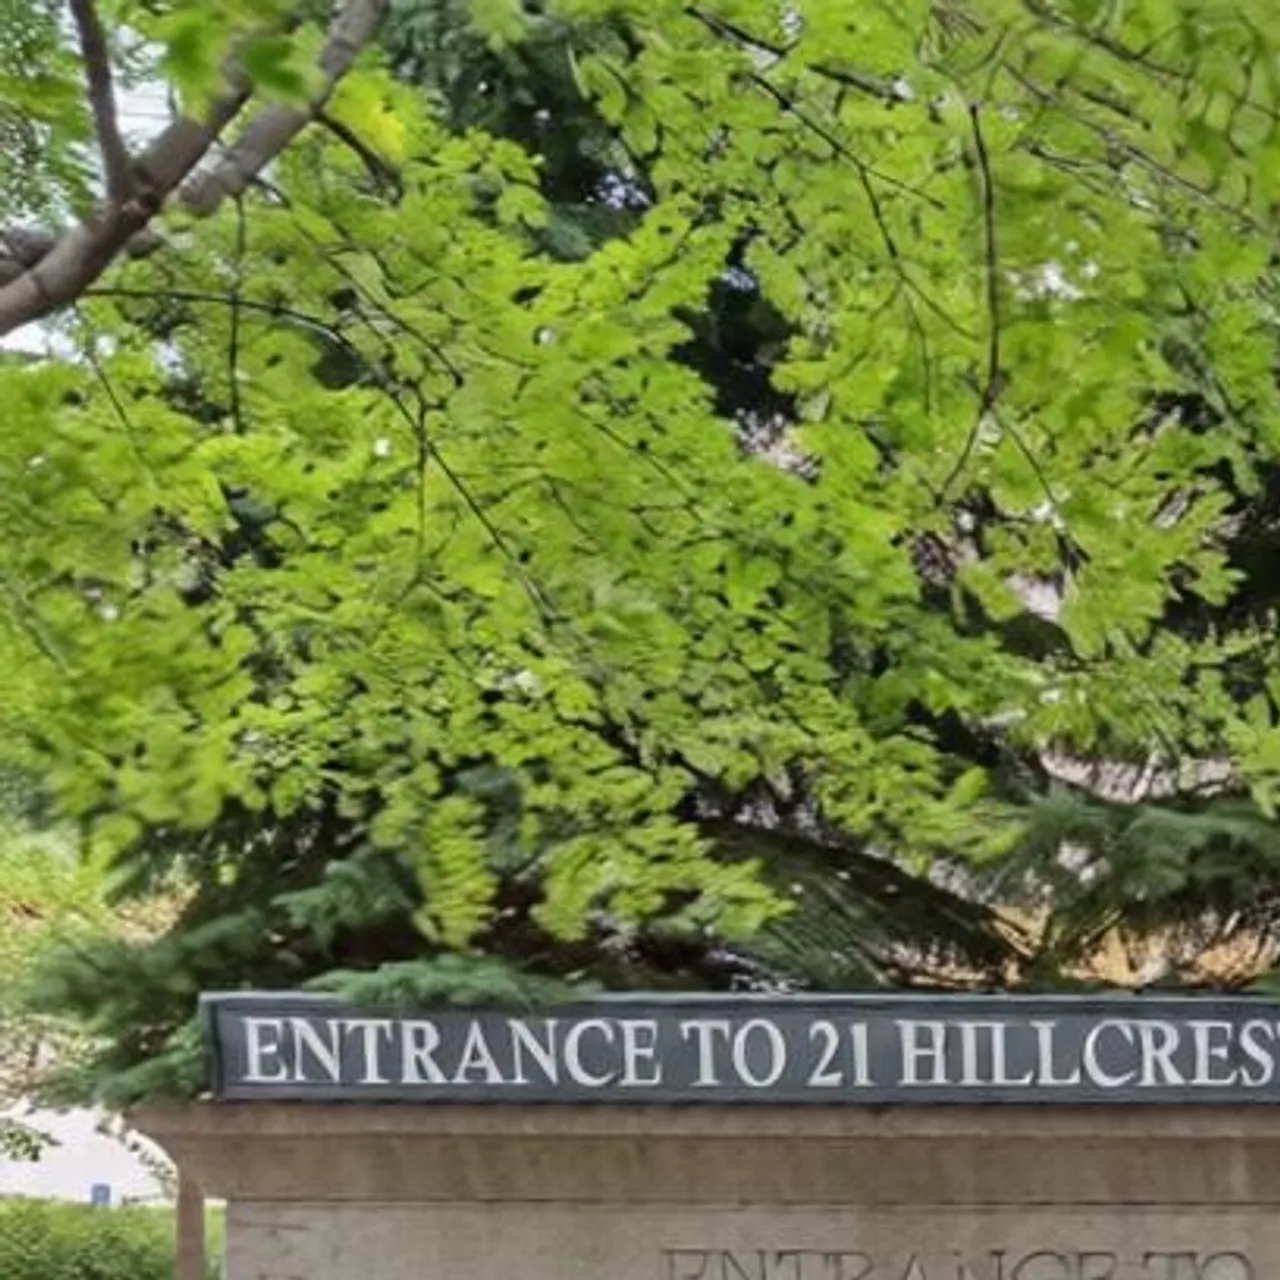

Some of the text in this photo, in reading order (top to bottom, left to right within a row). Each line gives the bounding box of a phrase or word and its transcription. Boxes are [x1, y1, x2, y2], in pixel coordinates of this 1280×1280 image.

[242, 1016, 662, 1086] ENTRANCE
[681, 1018, 786, 1087] TO
[807, 1020, 875, 1087] 21
